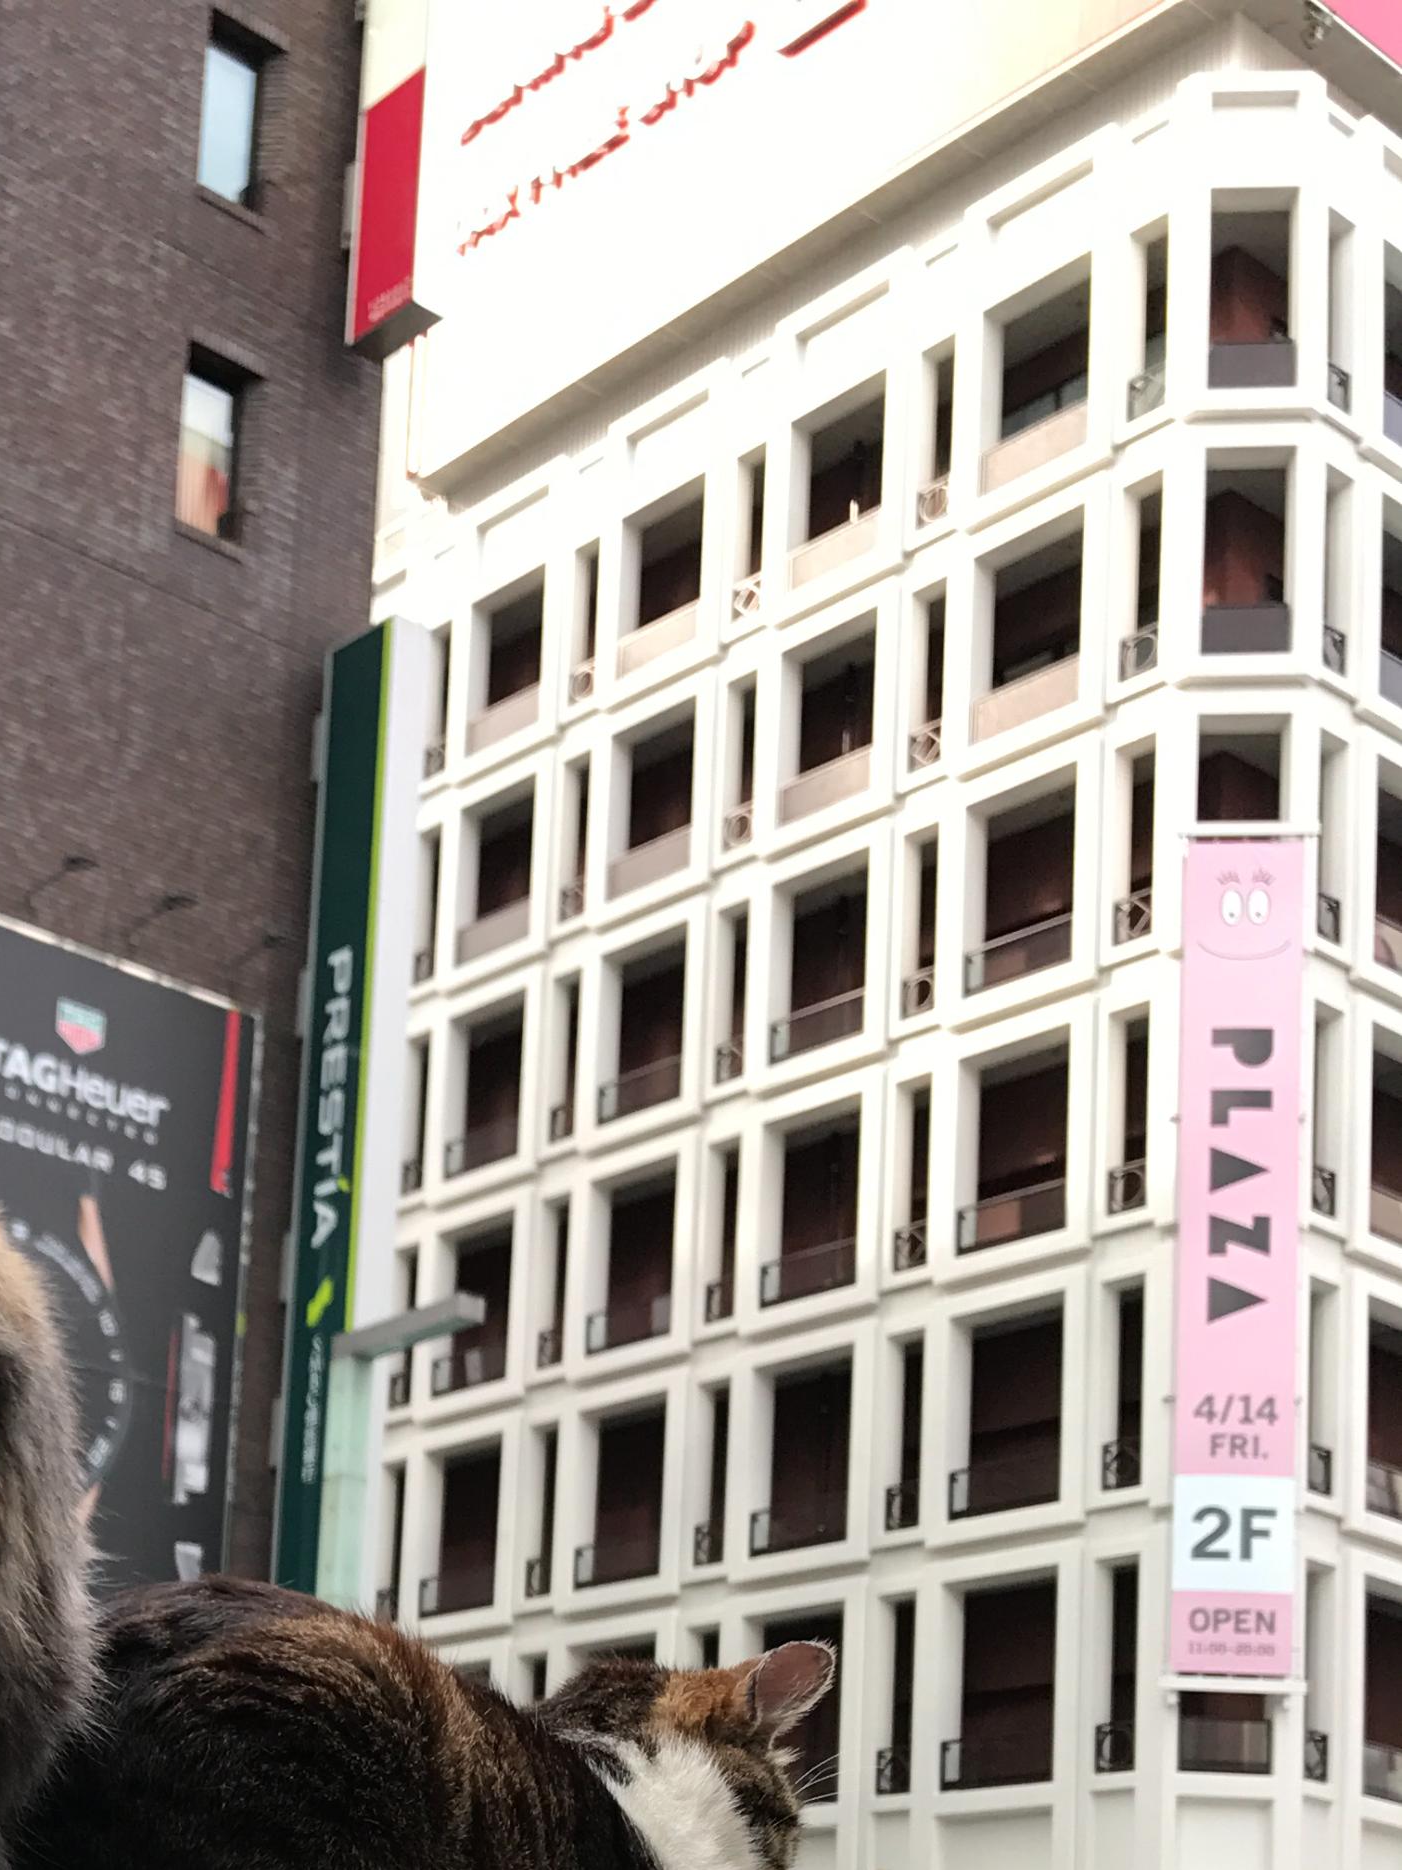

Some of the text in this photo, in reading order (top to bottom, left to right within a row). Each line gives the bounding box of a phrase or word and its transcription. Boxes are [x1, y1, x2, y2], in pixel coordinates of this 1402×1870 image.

[311, 944, 353, 1249] PRESTIA
[127, 1159, 167, 1190] 45
[1207, 1028, 1274, 1325] PLAZA
[1193, 1394, 1279, 1426] 4/14
[1209, 1433, 1269, 1460] FRI.
[1189, 1505, 1277, 1561] 2F
[1188, 1607, 1276, 1635] OPEN
